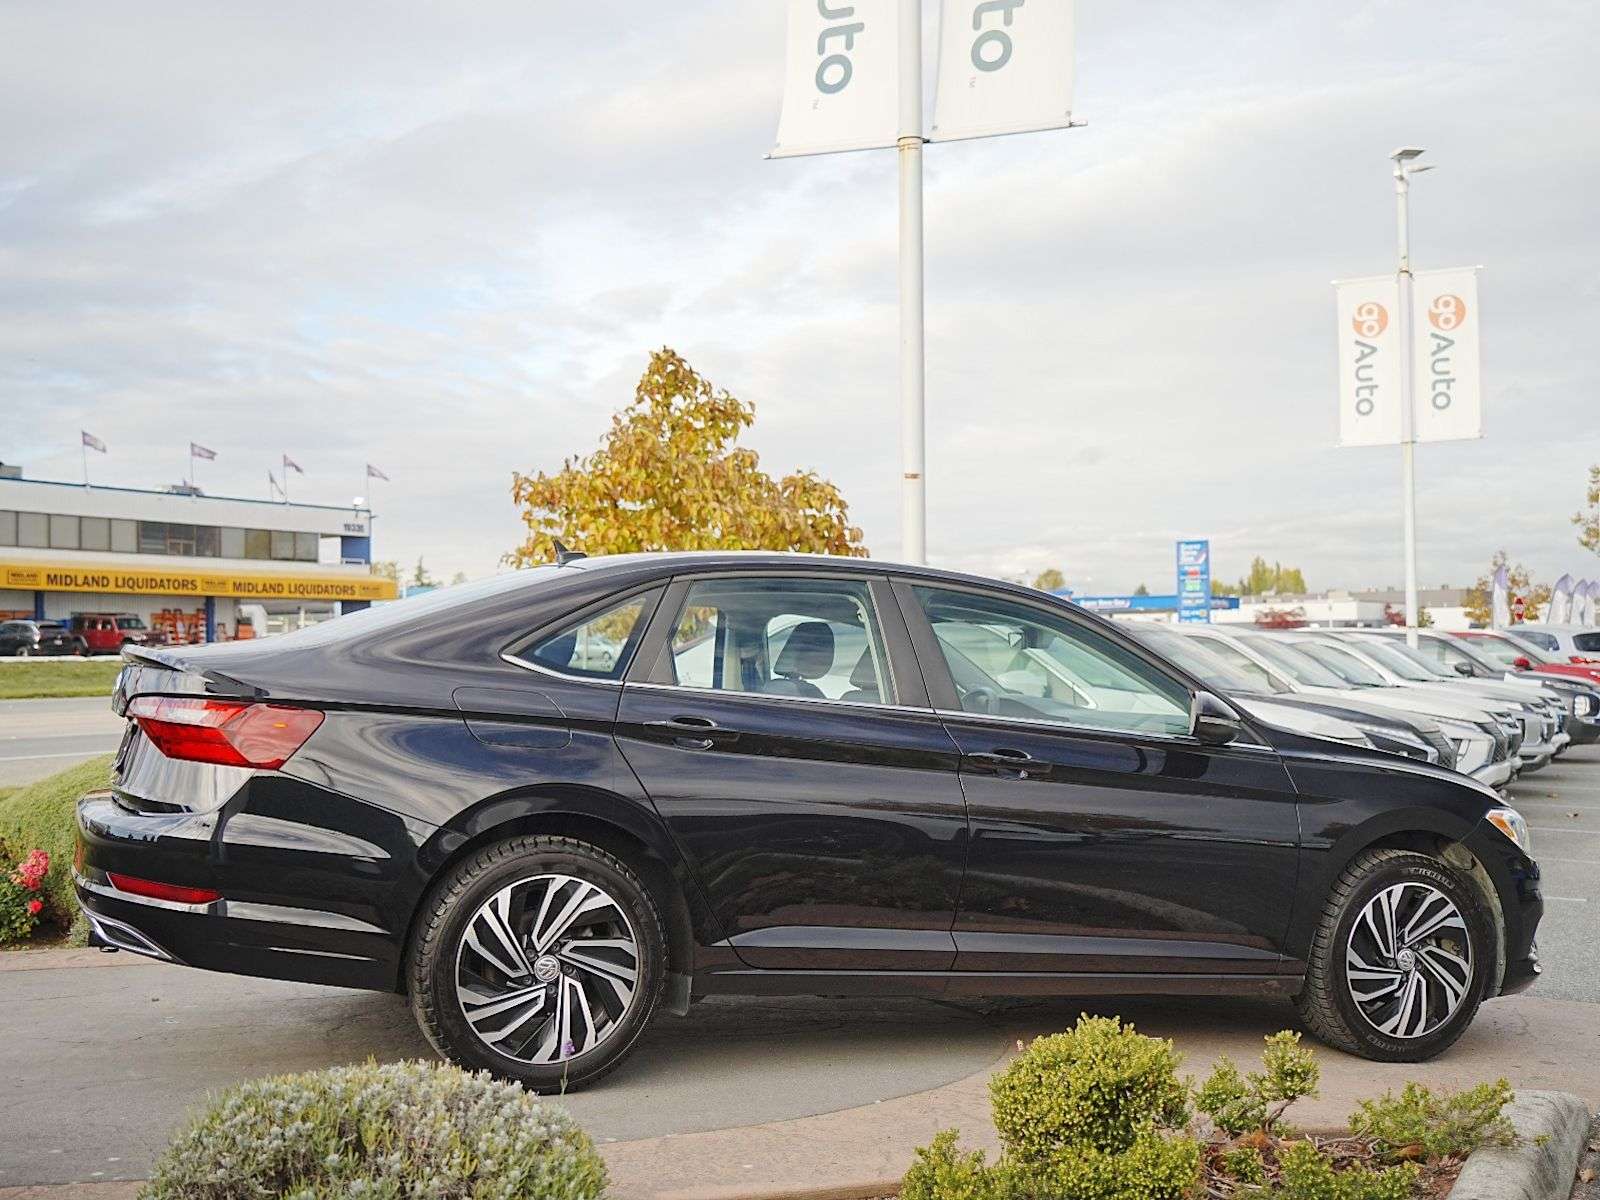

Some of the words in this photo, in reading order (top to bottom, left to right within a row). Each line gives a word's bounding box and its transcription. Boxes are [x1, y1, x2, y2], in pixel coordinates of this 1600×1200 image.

[1354, 340, 1379, 416] Auto
[1430, 332, 1456, 410] Auto
[46, 573, 110, 588] MIDLAND
[115, 576, 198, 591] LIQUIDATORS
[232, 581, 284, 594] MIDLAND
[288, 583, 356, 596] LIQUIDATORS
